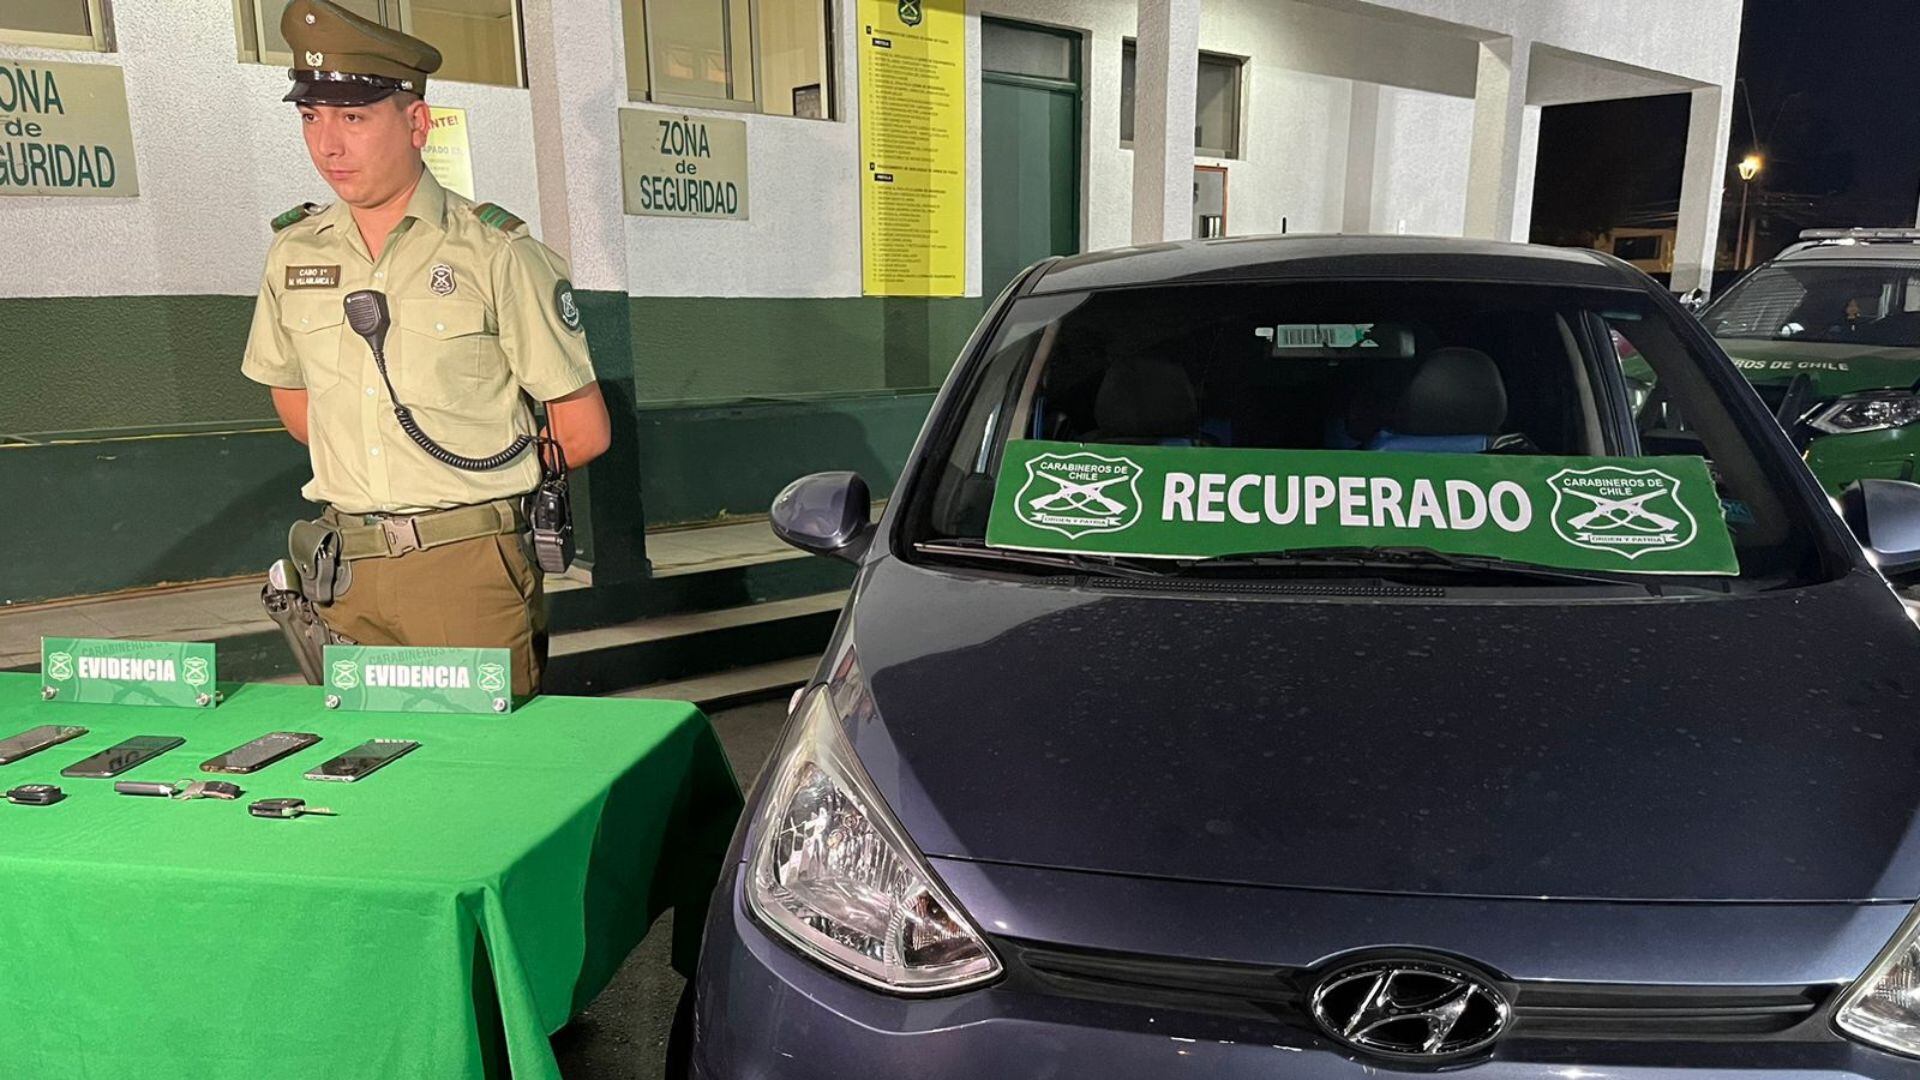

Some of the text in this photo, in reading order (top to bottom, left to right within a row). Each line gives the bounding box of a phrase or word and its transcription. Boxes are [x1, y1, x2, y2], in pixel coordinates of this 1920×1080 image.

[5, 117, 42, 137] de
[428, 115, 459, 130] NTE!
[659, 120, 710, 158] ZONA
[675, 160, 697, 175] de
[640, 175, 738, 214] SEGURIDAD
[1769, 360, 1794, 370] DE
[1797, 361, 1850, 371] CHILE
[1040, 461, 1128, 474] CARABINEROS DE
[1068, 472, 1098, 481] CHILE
[1563, 478, 1664, 488] CARABINEROS DE
[1599, 486, 1634, 496] CHILE
[1161, 472, 1532, 532] RECUPERADO
[78, 656, 176, 682] EVIDENCIA
[365, 664, 470, 688] EVIDENCIA
